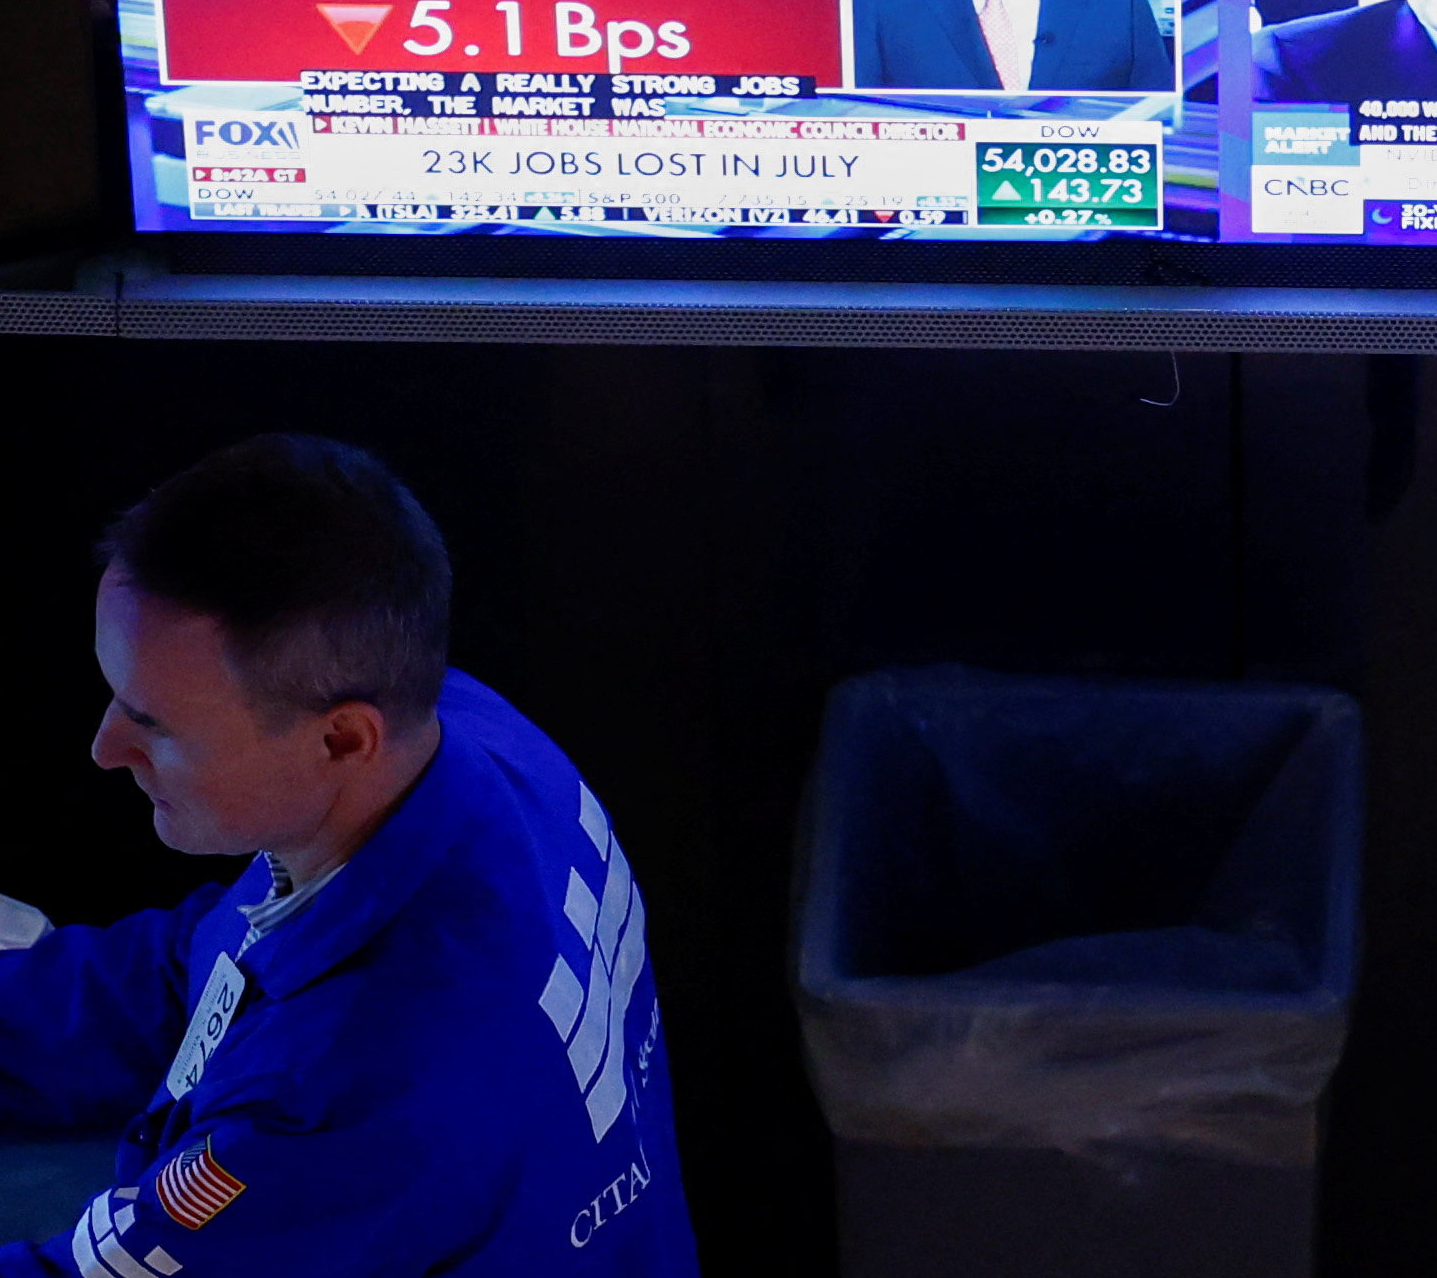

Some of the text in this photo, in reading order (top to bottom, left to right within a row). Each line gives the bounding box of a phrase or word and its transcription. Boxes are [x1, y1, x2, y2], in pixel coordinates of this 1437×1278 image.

[402, 0, 690, 74] 5.1 Bps
[301, 71, 799, 97] EXPECTING A REALLY STRONG JOBS
[302, 96, 665, 116] NUMBER, THE MARKET WAS
[195, 121, 281, 146] FOX
[1041, 125, 1100, 138] DOW
[422, 150, 860, 178] 23K JOBS LOST IN JULY
[982, 148, 1151, 175] 54,028.83
[1031, 178, 1143, 204] 143.73
[1264, 179, 1349, 196] CNBC
